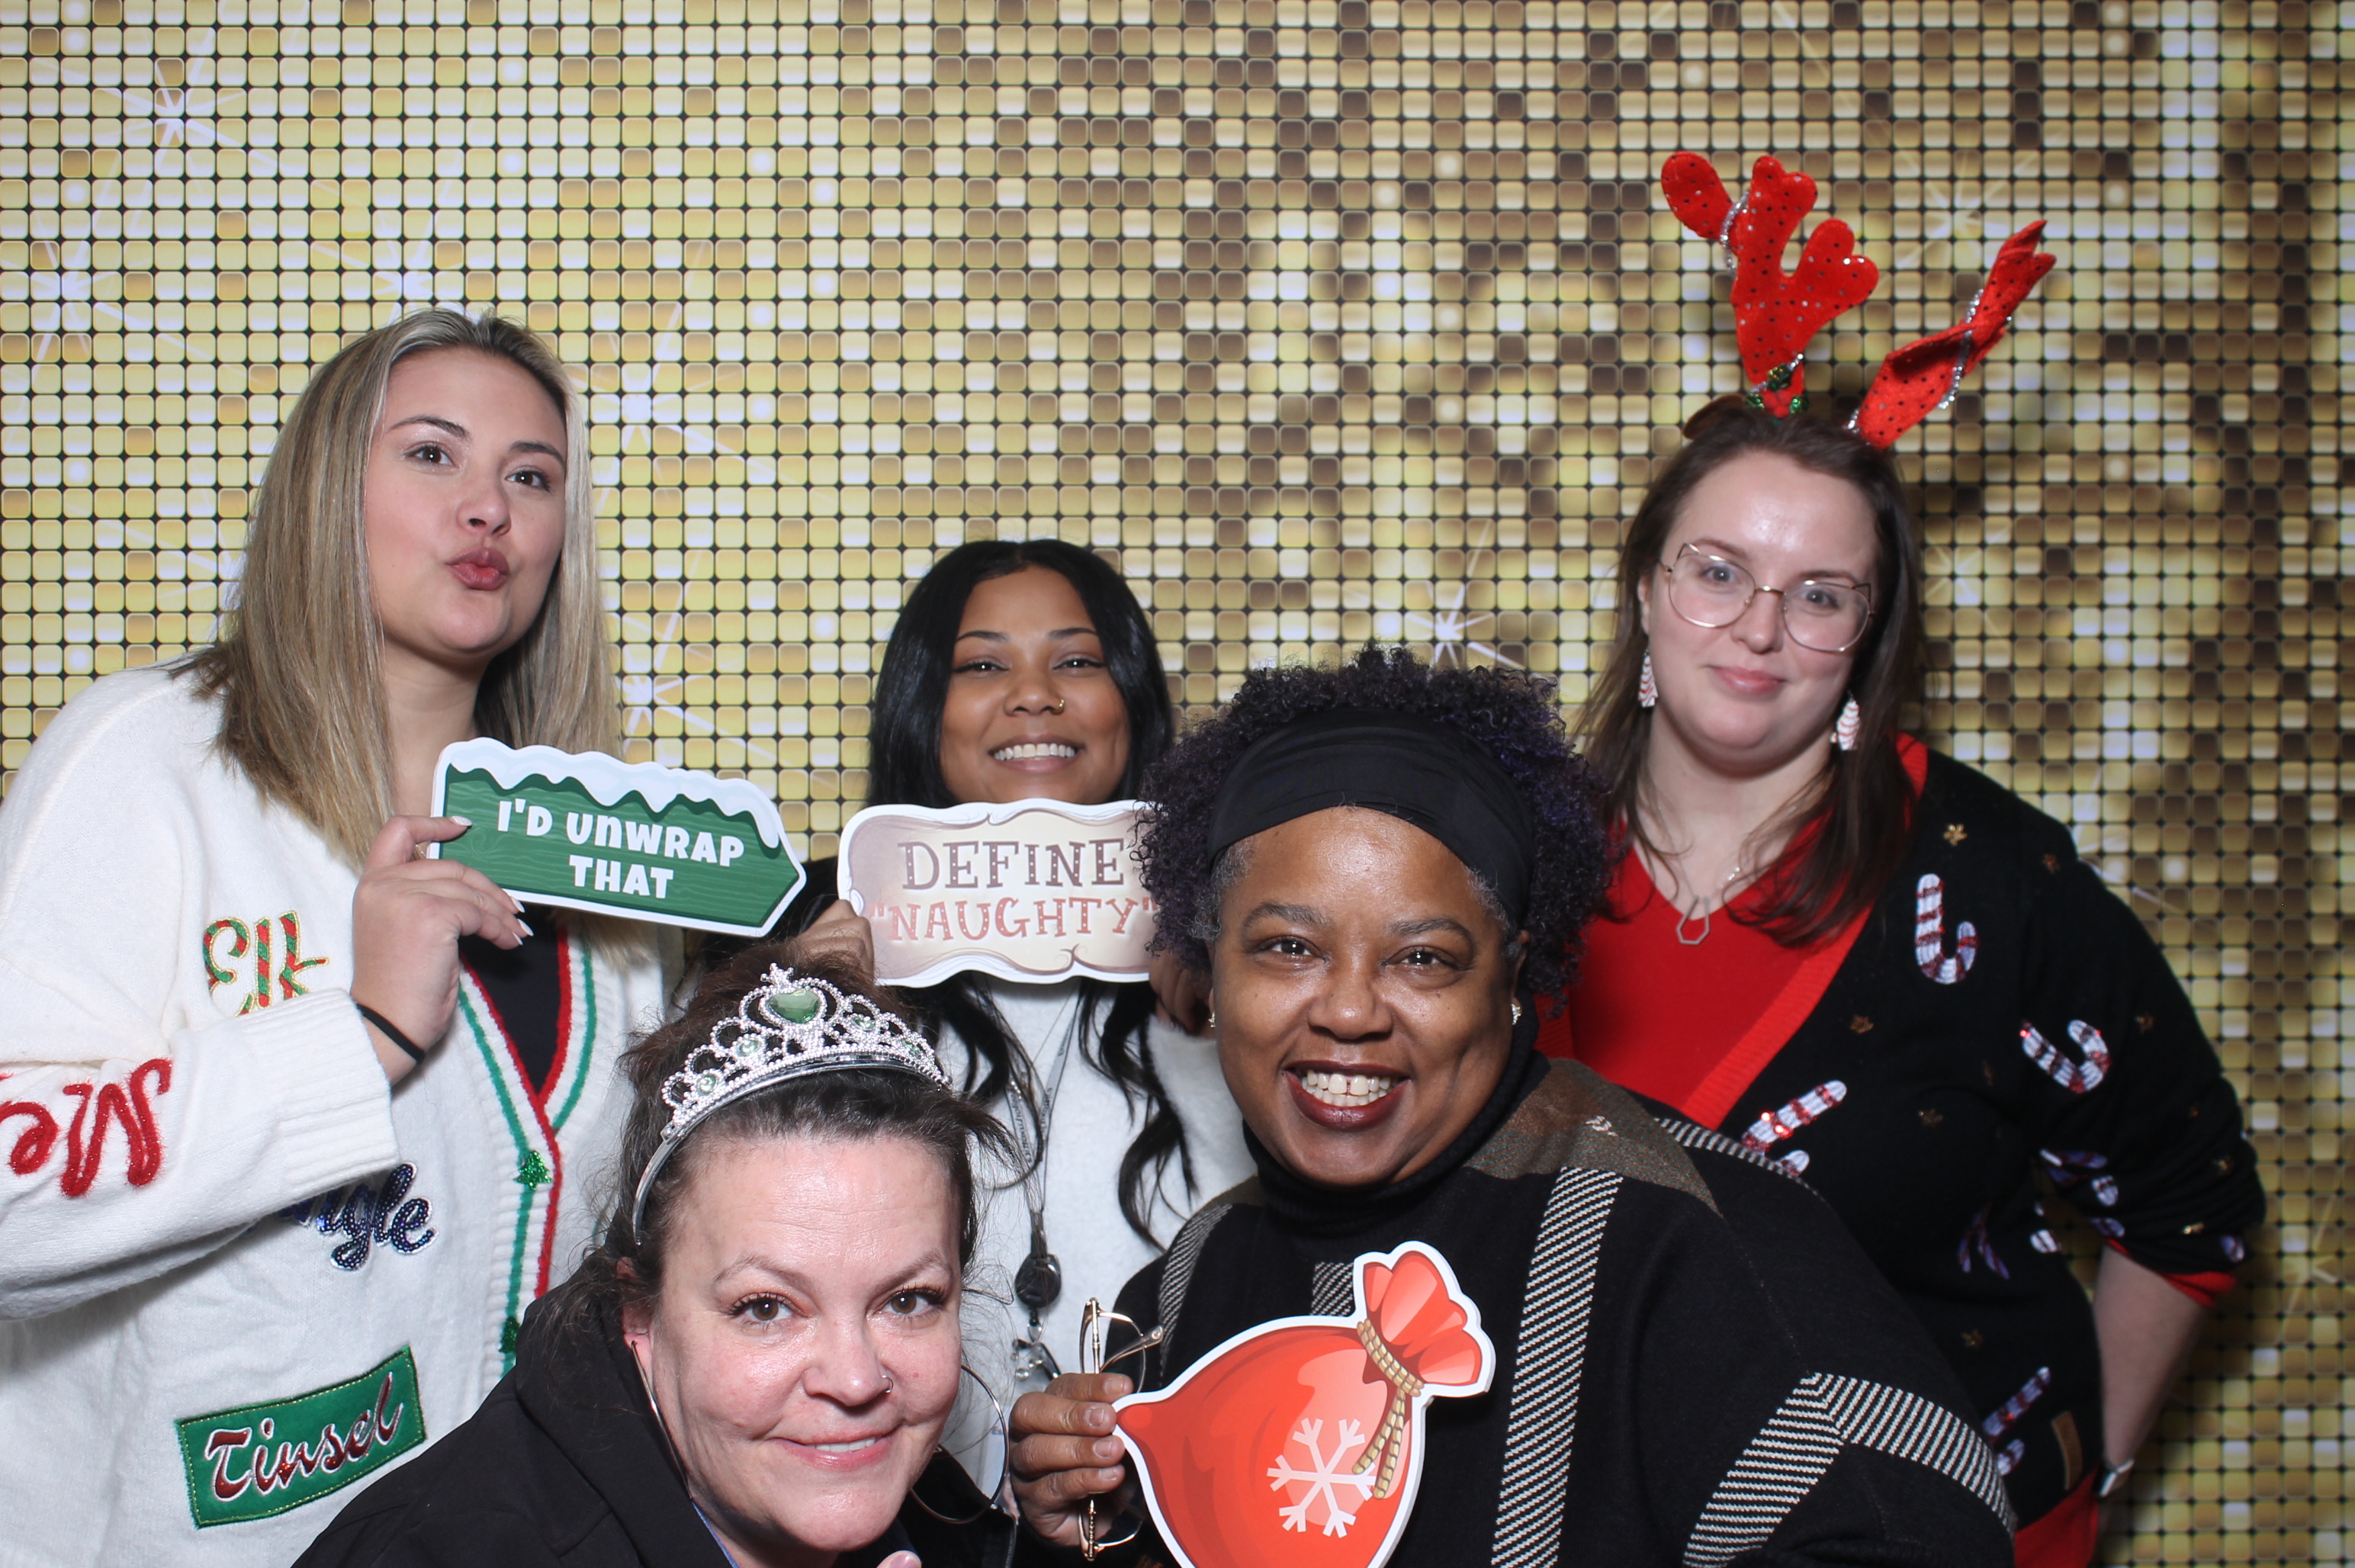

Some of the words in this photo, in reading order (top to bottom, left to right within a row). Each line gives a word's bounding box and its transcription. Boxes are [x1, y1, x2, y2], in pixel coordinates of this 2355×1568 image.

[496, 798, 554, 837] I'D
[566, 811, 745, 868] UNWRAP
[568, 854, 674, 899] THAT
[897, 838, 1124, 890] DEFINE
[204, 1370, 404, 1502] Tinsel
